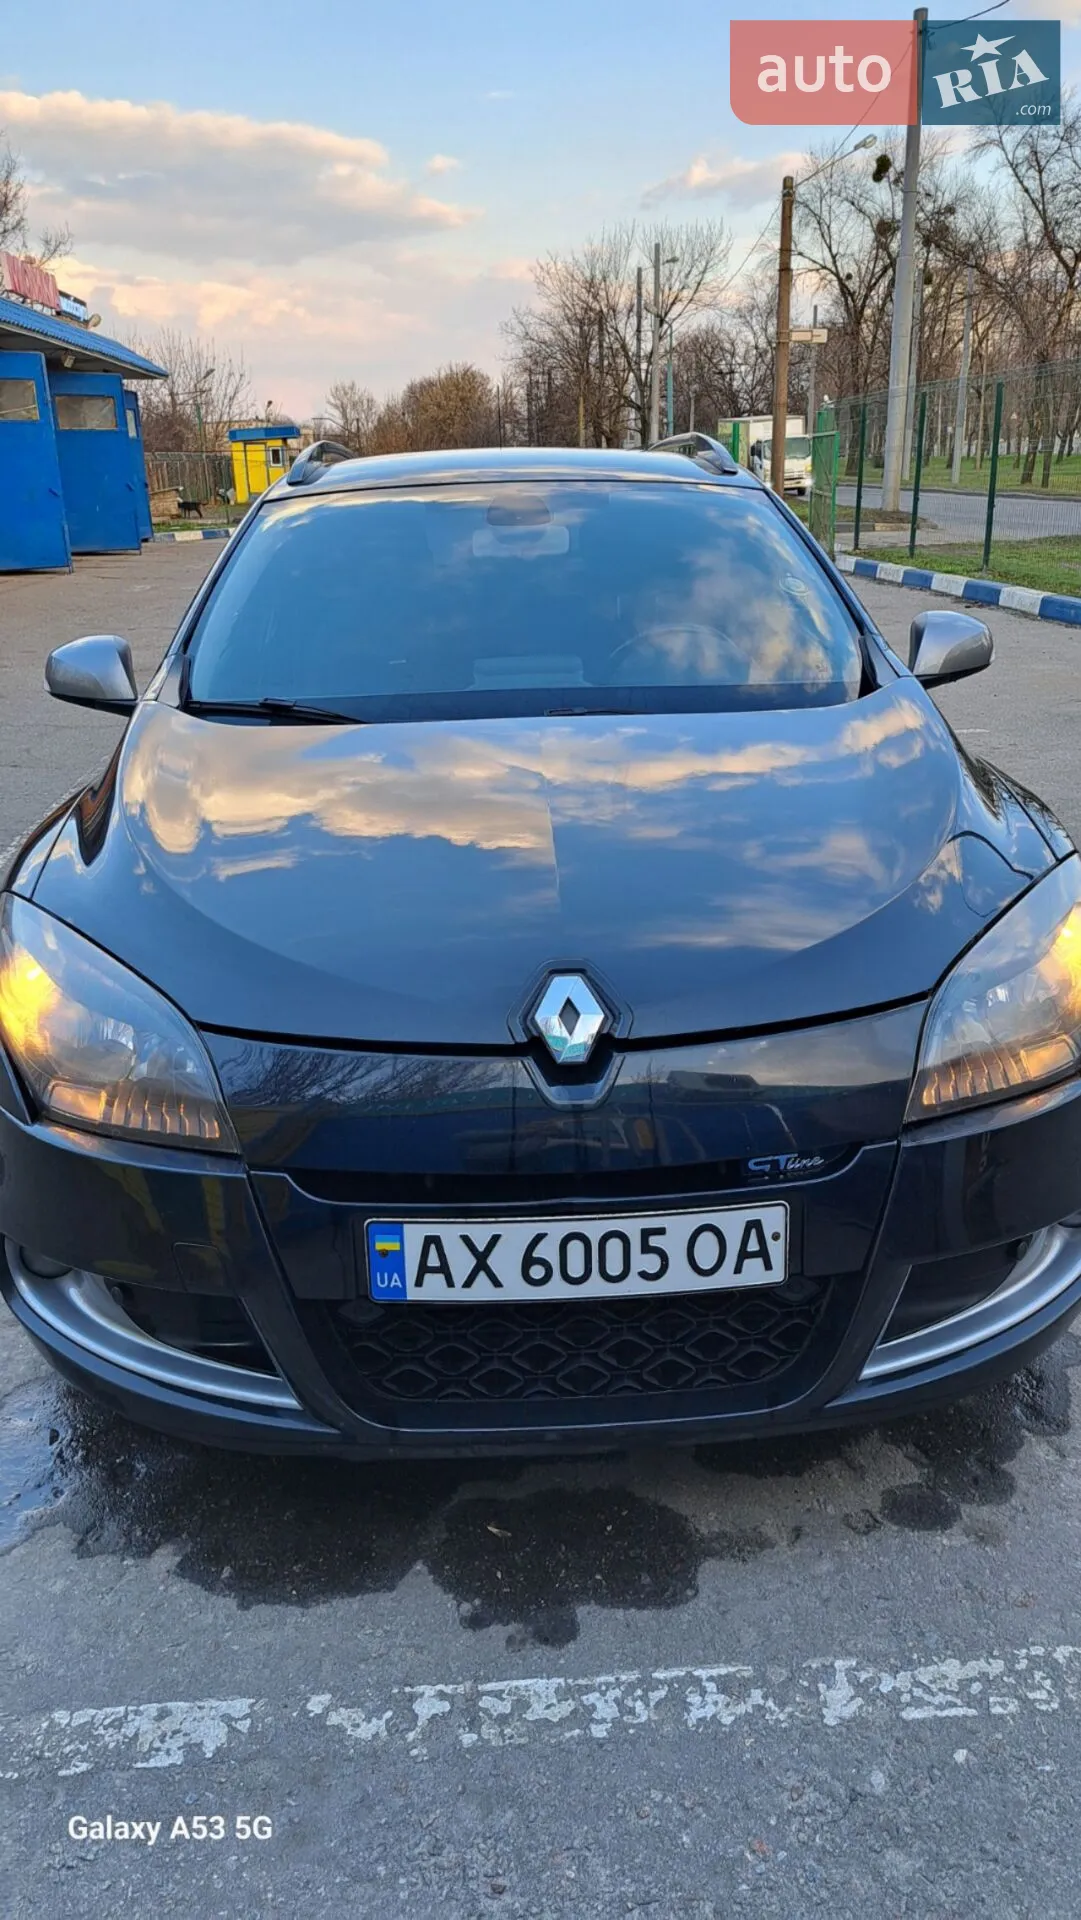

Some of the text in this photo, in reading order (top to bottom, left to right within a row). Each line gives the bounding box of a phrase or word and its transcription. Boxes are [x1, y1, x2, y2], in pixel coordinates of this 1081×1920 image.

[414, 1218, 774, 1289] AX 6005 OA
[376, 1272, 403, 1288] UA
